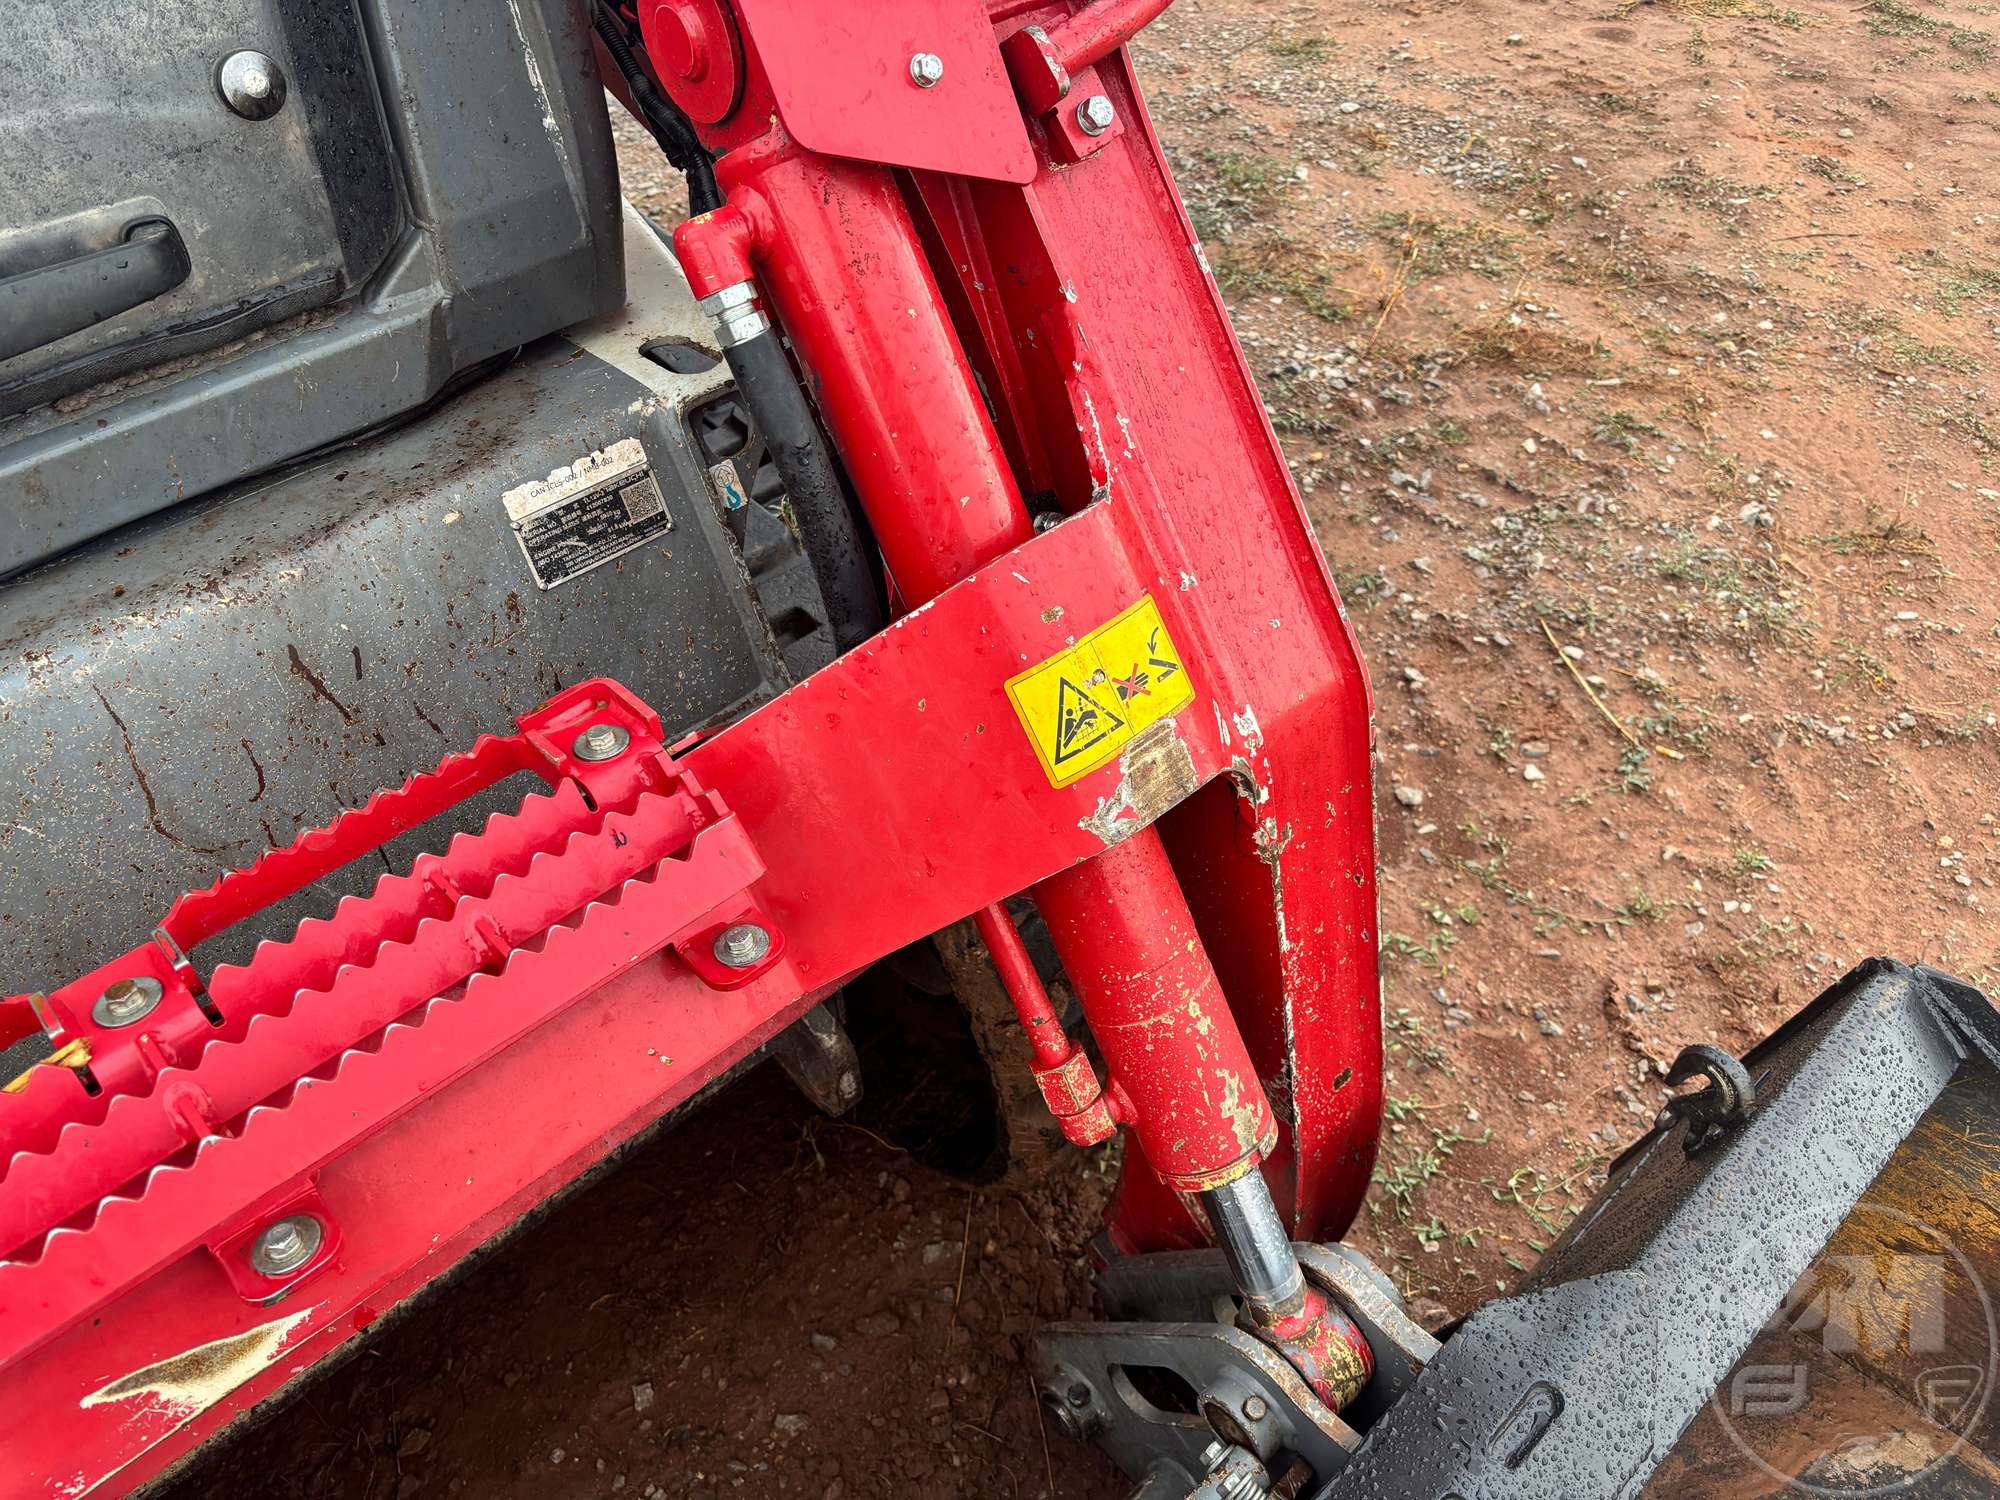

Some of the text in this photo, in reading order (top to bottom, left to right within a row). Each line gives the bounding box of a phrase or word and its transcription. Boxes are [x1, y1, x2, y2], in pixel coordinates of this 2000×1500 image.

[530, 486, 546, 498] CAN
[526, 526, 562, 546] OPERATING
[533, 545, 557, 560] ENGINE
